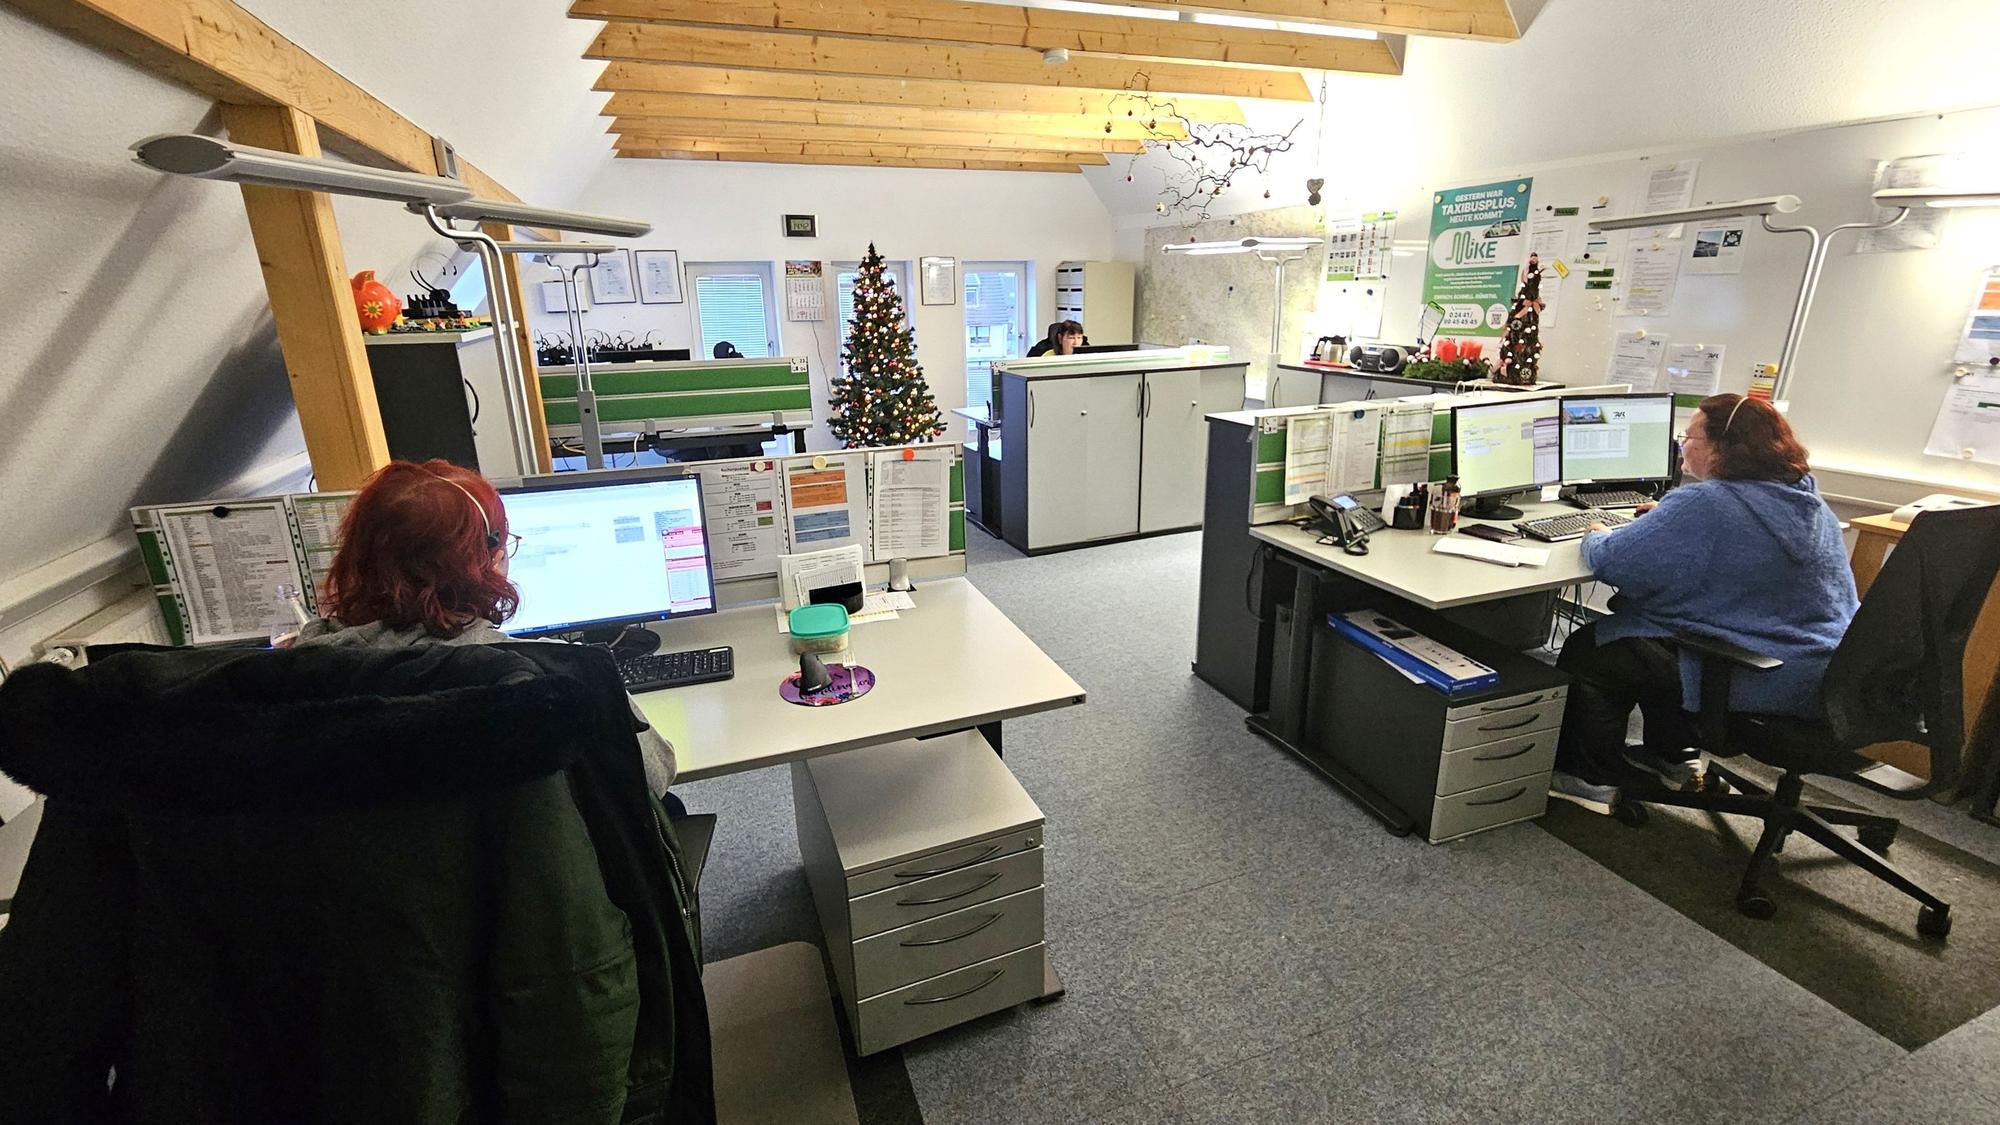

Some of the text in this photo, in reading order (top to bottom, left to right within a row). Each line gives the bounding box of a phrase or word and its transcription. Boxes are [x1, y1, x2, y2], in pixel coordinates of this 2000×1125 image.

[1455, 189, 1503, 202] GESTERN WAR
[1442, 197, 1517, 216] TAXIBUSPLUS,
[1449, 210, 1503, 223] HEUTE KOMMT
